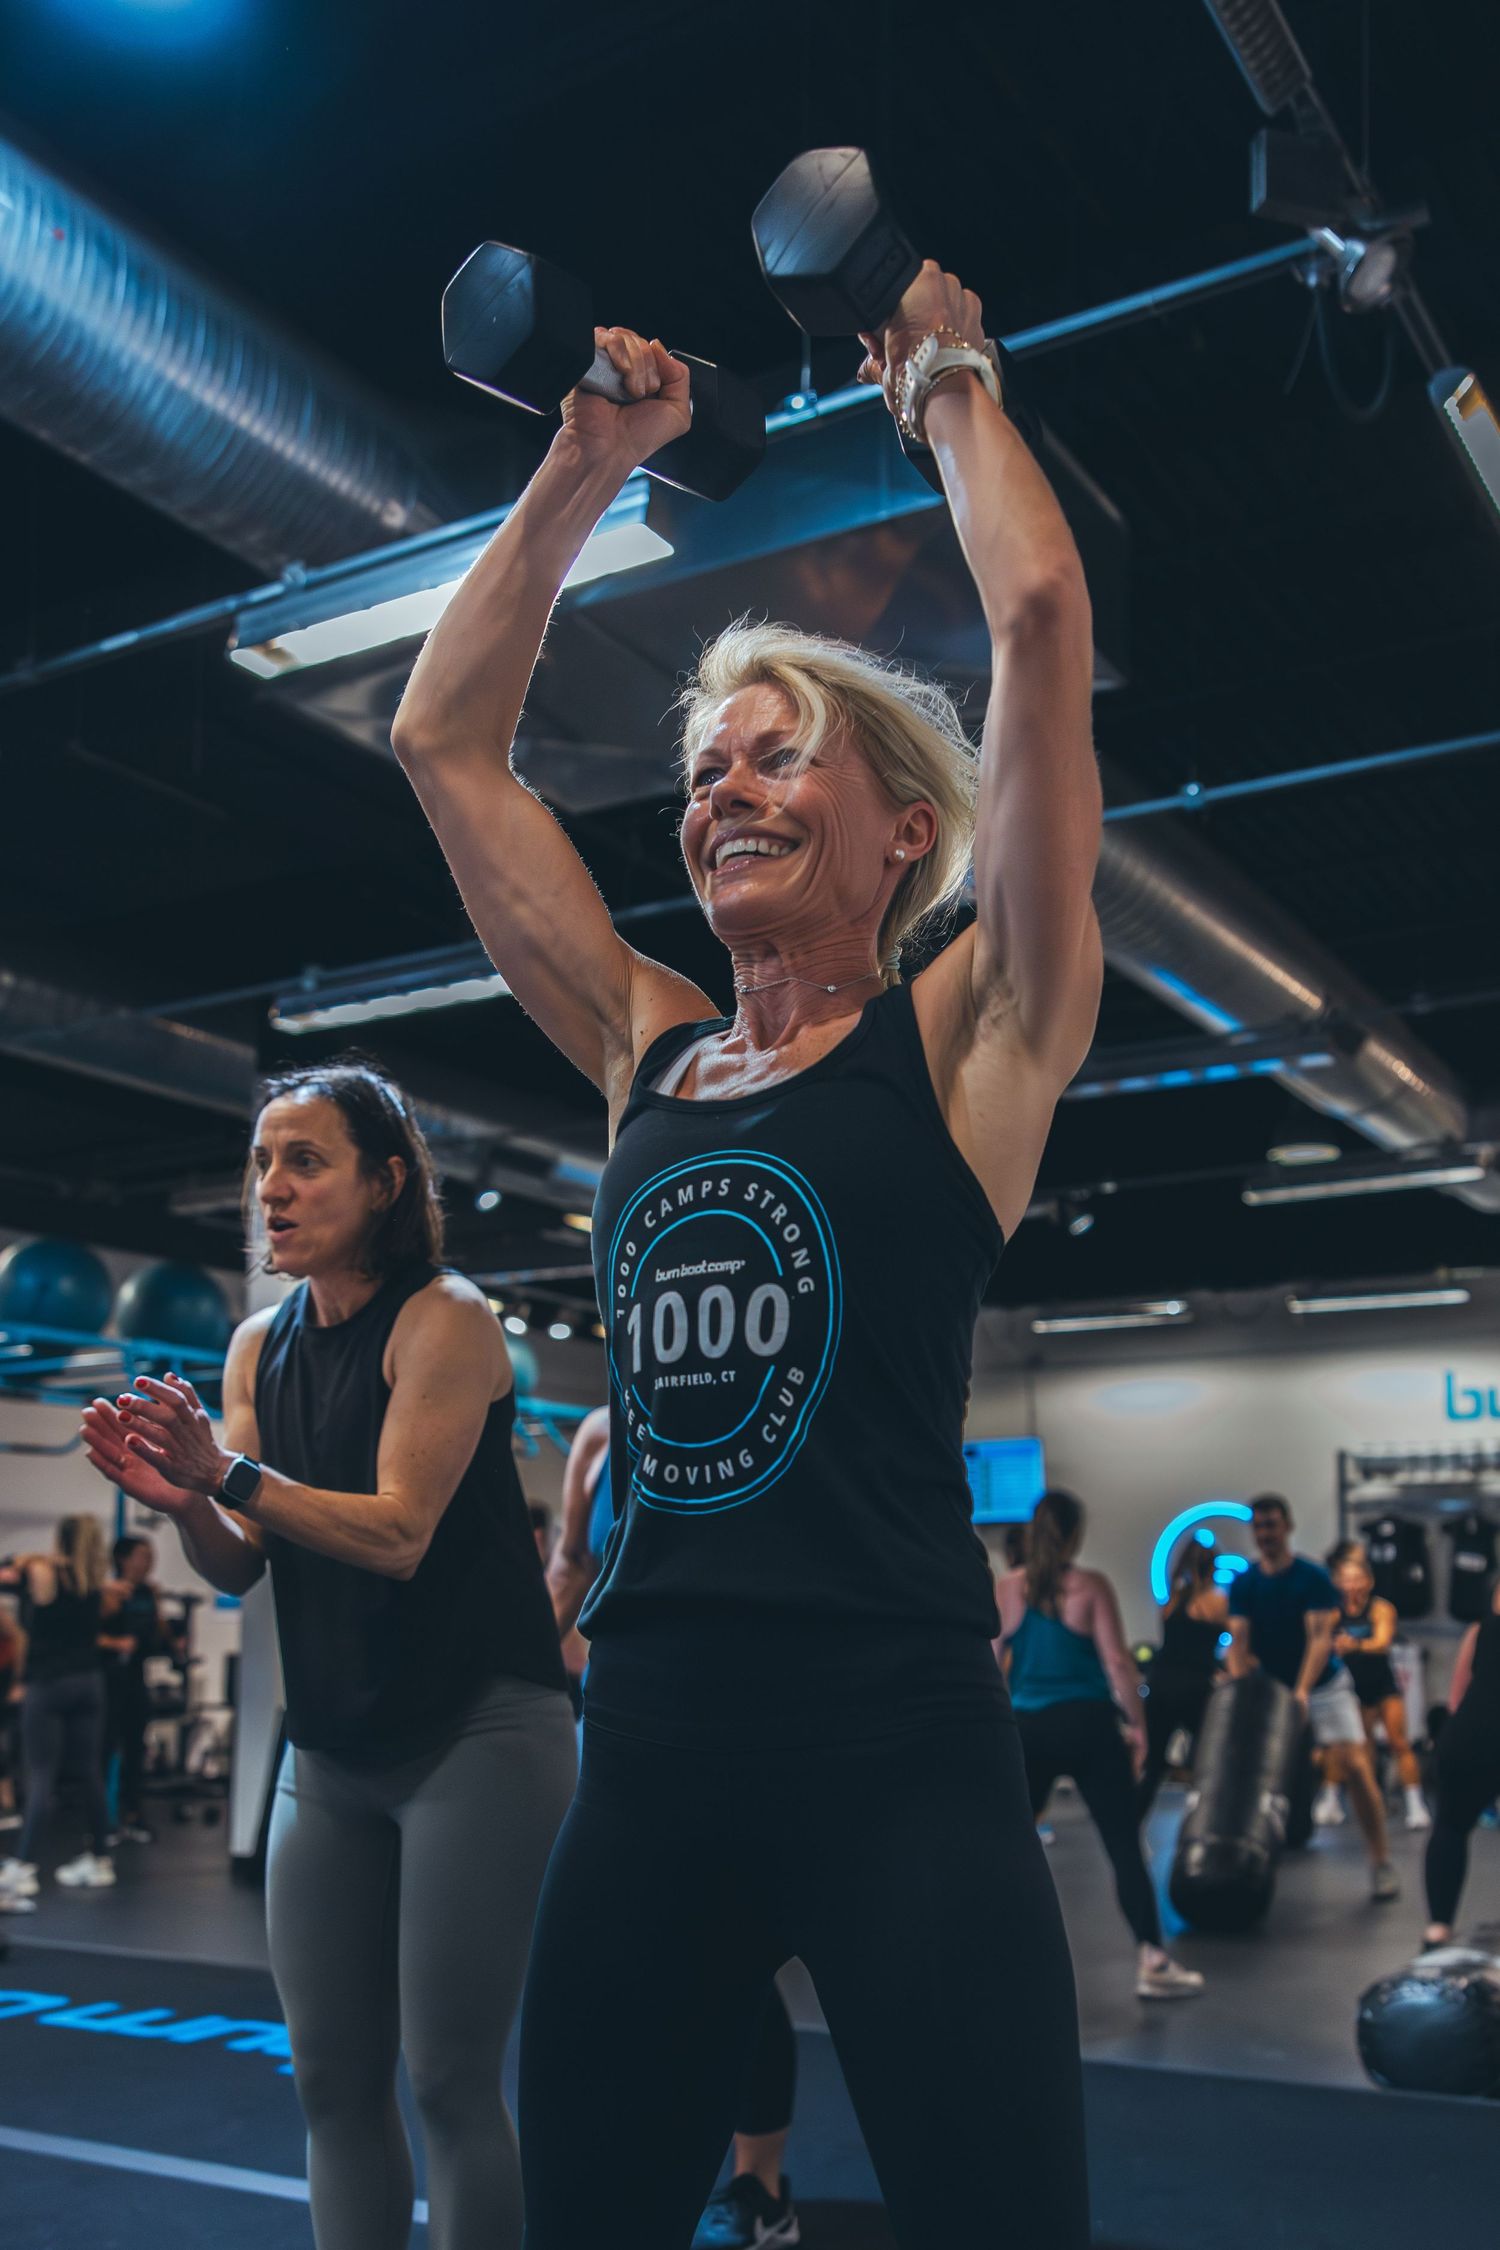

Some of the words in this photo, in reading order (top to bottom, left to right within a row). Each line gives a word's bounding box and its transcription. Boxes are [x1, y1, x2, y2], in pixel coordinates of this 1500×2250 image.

[616, 1241, 637, 1319] 1000
[644, 1178, 731, 1228] CAMPS
[743, 1182, 815, 1294] STRONG
[627, 1284, 789, 1374] 1000
[721, 1370, 736, 1383] CT
[642, 1449, 754, 1485] MOVING
[762, 1367, 804, 1443] CLUB
